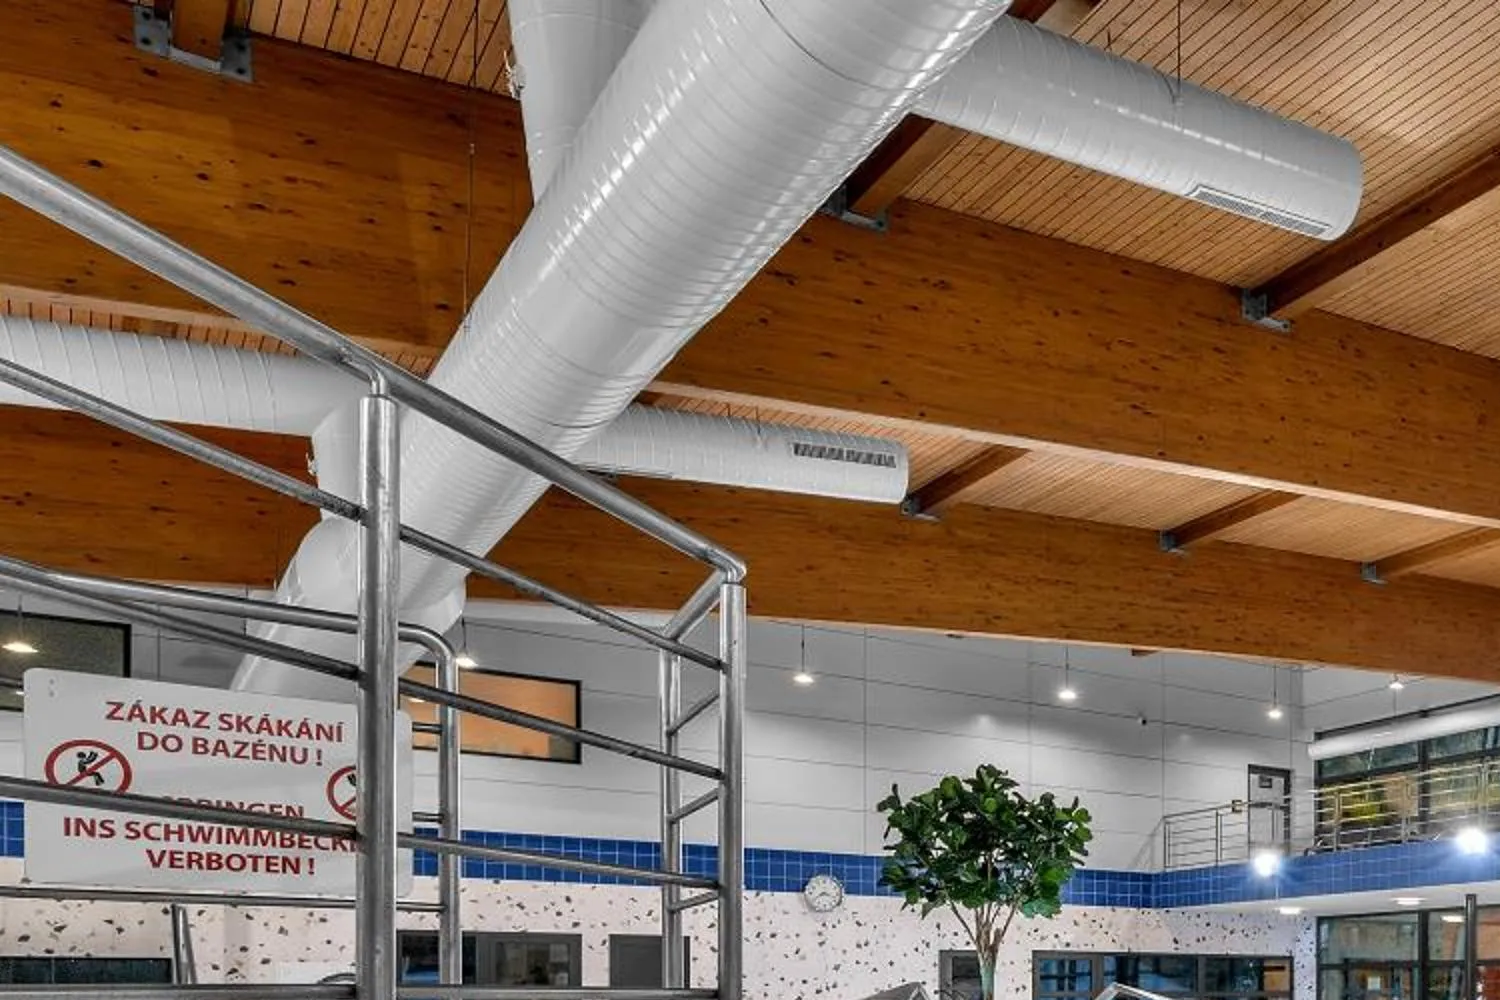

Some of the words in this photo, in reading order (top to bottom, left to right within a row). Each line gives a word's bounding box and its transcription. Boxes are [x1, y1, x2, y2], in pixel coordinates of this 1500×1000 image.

[105, 699, 211, 730] ZÁKAZ
[217, 713, 345, 743] SKÁKÁNÍ
[136, 731, 184, 753] DO
[191, 737, 309, 765] BAZÉNU
[315, 749, 323, 766] !
[63, 816, 117, 839] INS
[124, 821, 357, 853] SCHWIMMBECK
[145, 849, 300, 875] VERBOTEN
[307, 857, 315, 875] !
